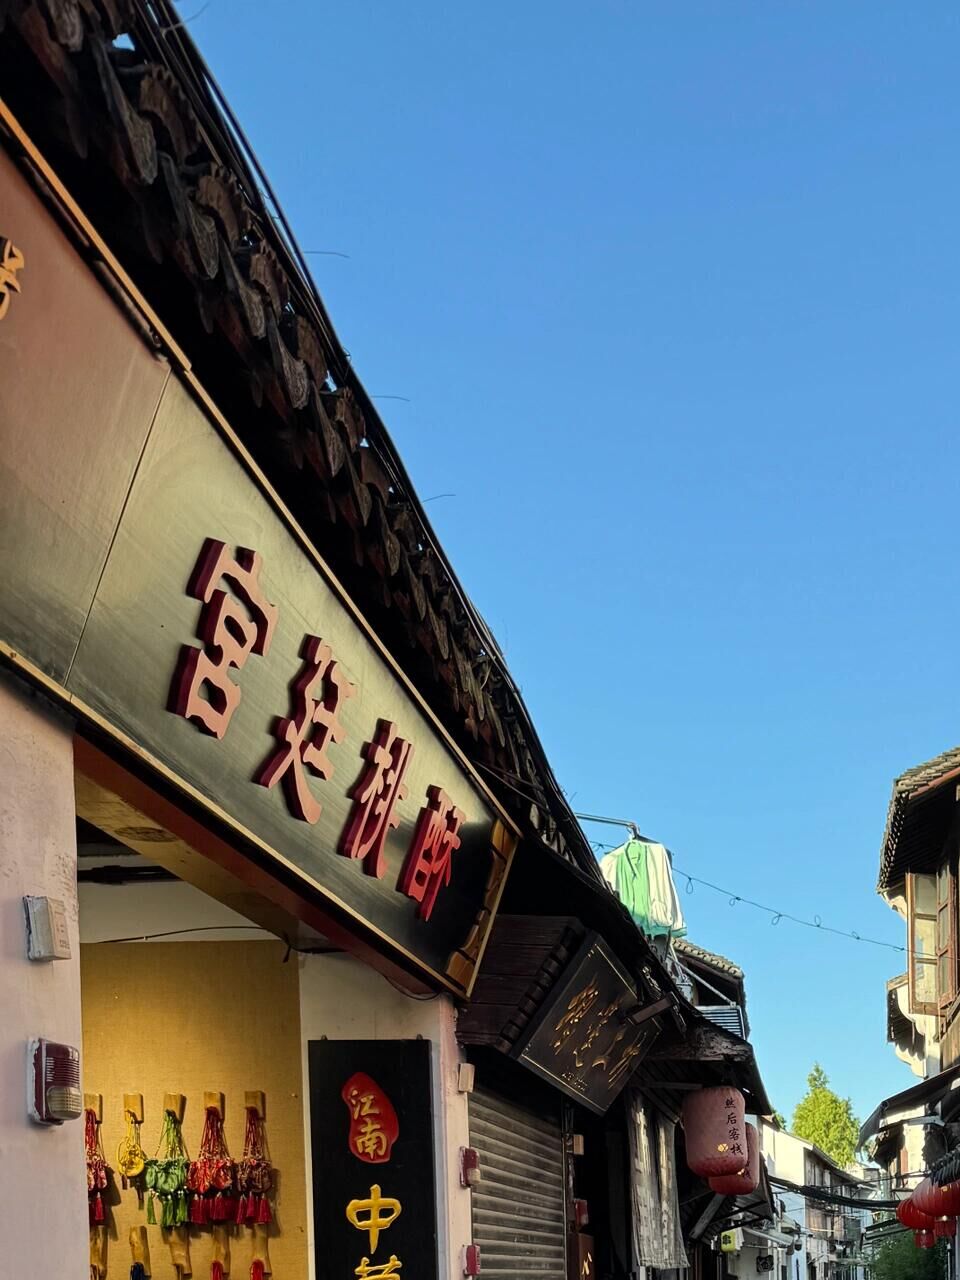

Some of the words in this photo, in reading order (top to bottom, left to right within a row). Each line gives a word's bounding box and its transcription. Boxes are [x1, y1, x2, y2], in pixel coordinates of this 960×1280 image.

[167, 537, 466, 922] 宫廷桃酥
[351, 1089, 387, 1160] 江南
[724, 1097, 744, 1155] 然后客栈
